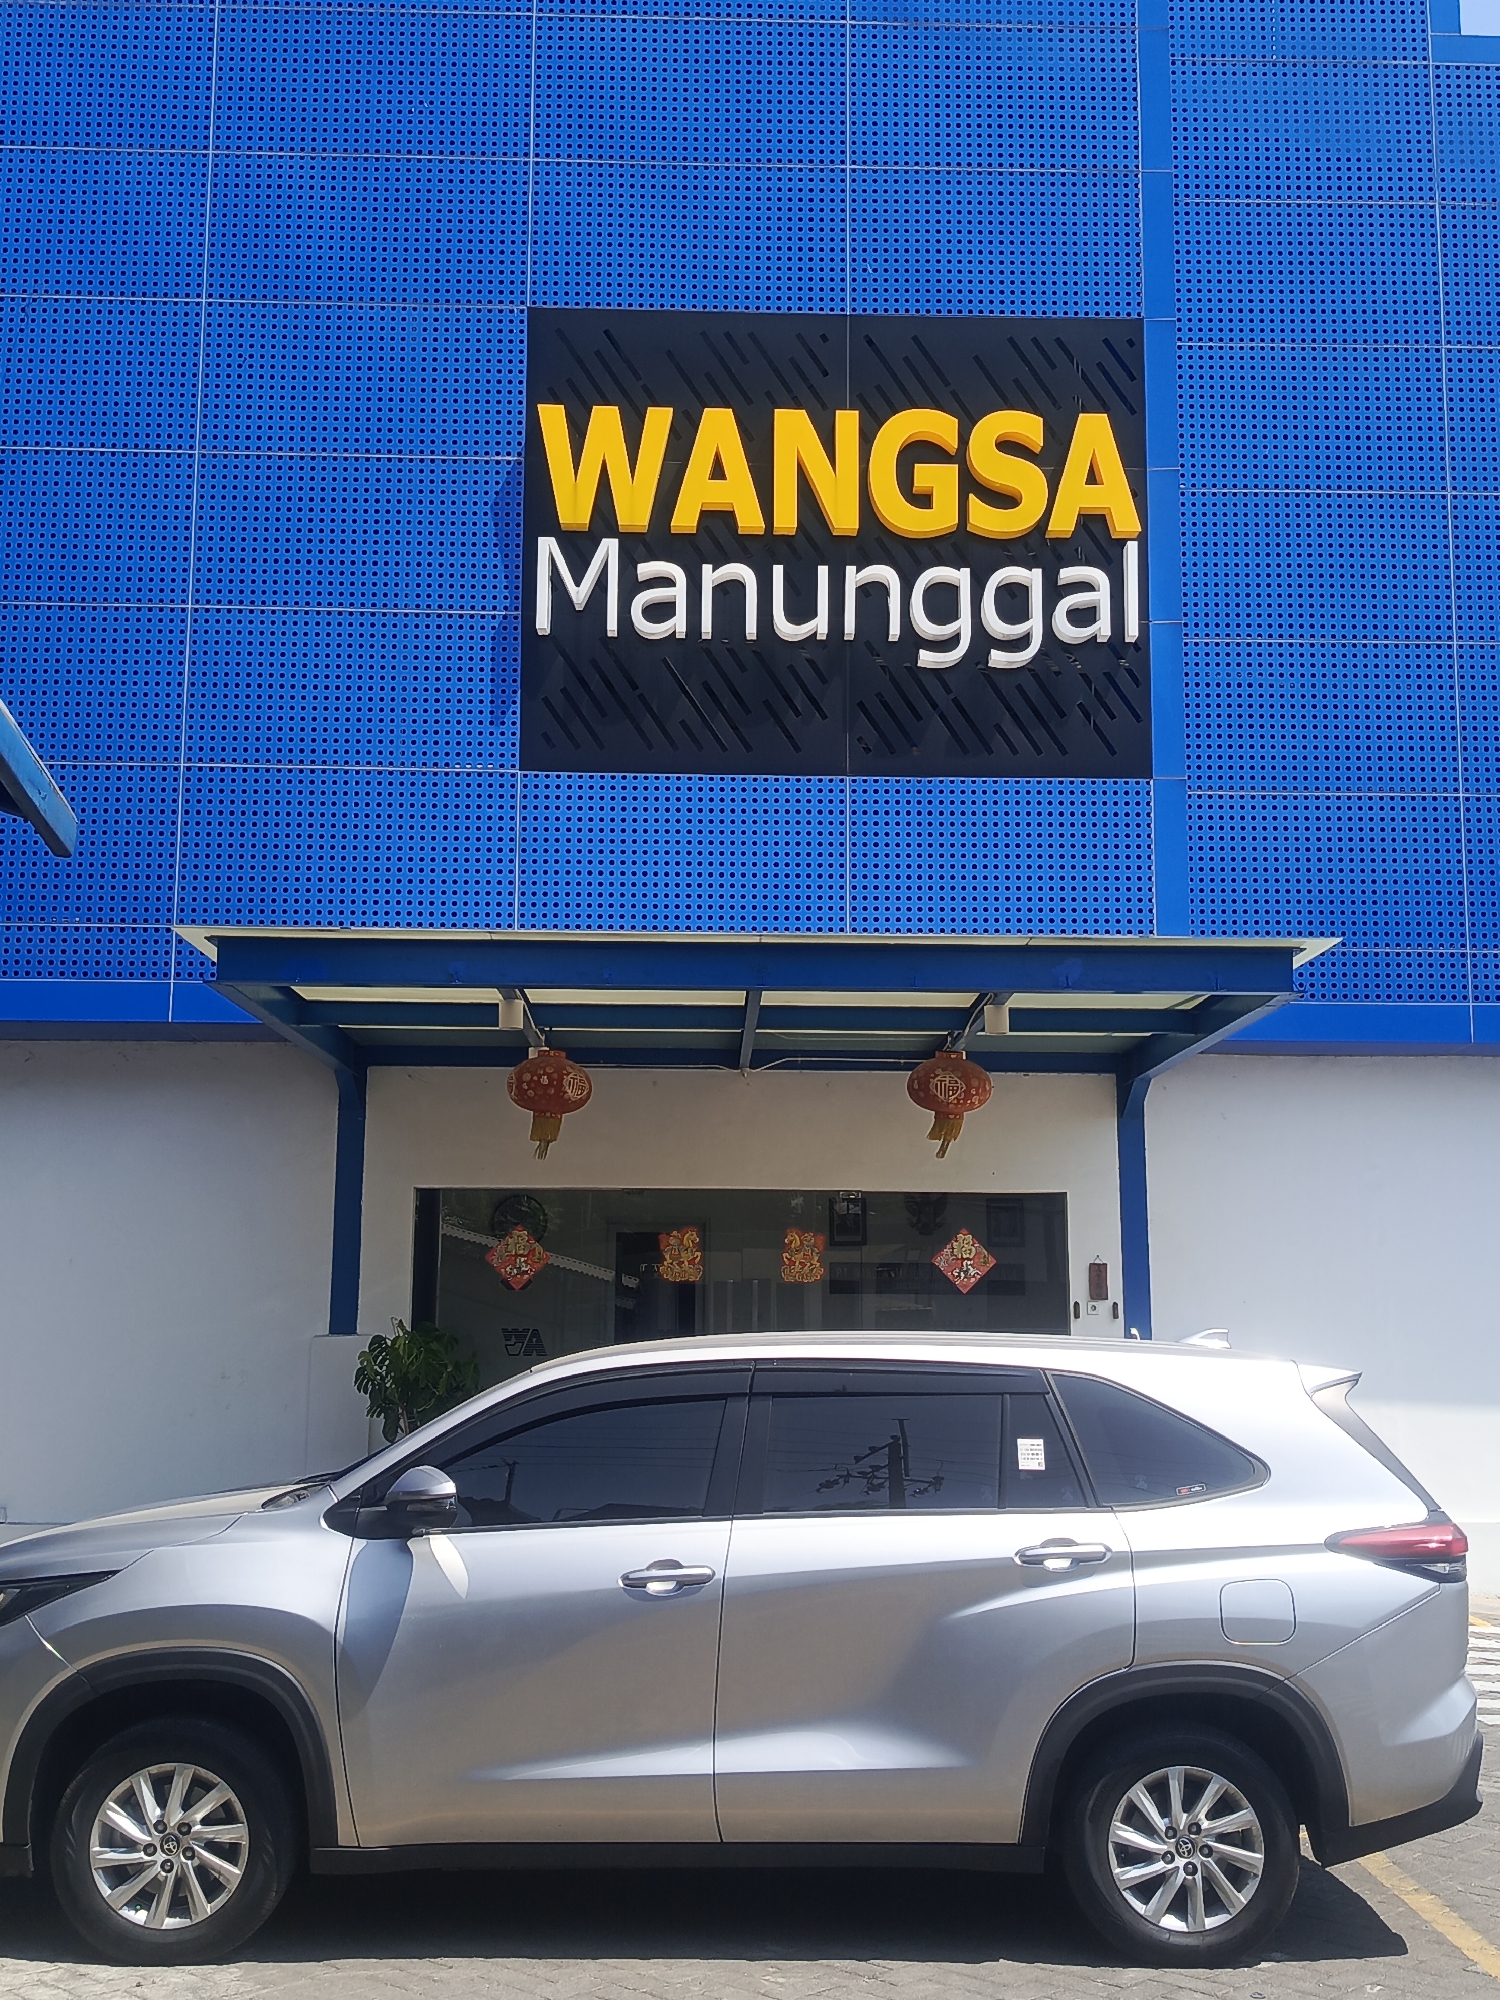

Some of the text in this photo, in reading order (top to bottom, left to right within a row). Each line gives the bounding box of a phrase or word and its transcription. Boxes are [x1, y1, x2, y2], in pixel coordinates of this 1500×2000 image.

[538, 404, 1141, 539] WANGSA
[536, 537, 1139, 668] Manunggal
[934, 1074, 961, 1101] 福
